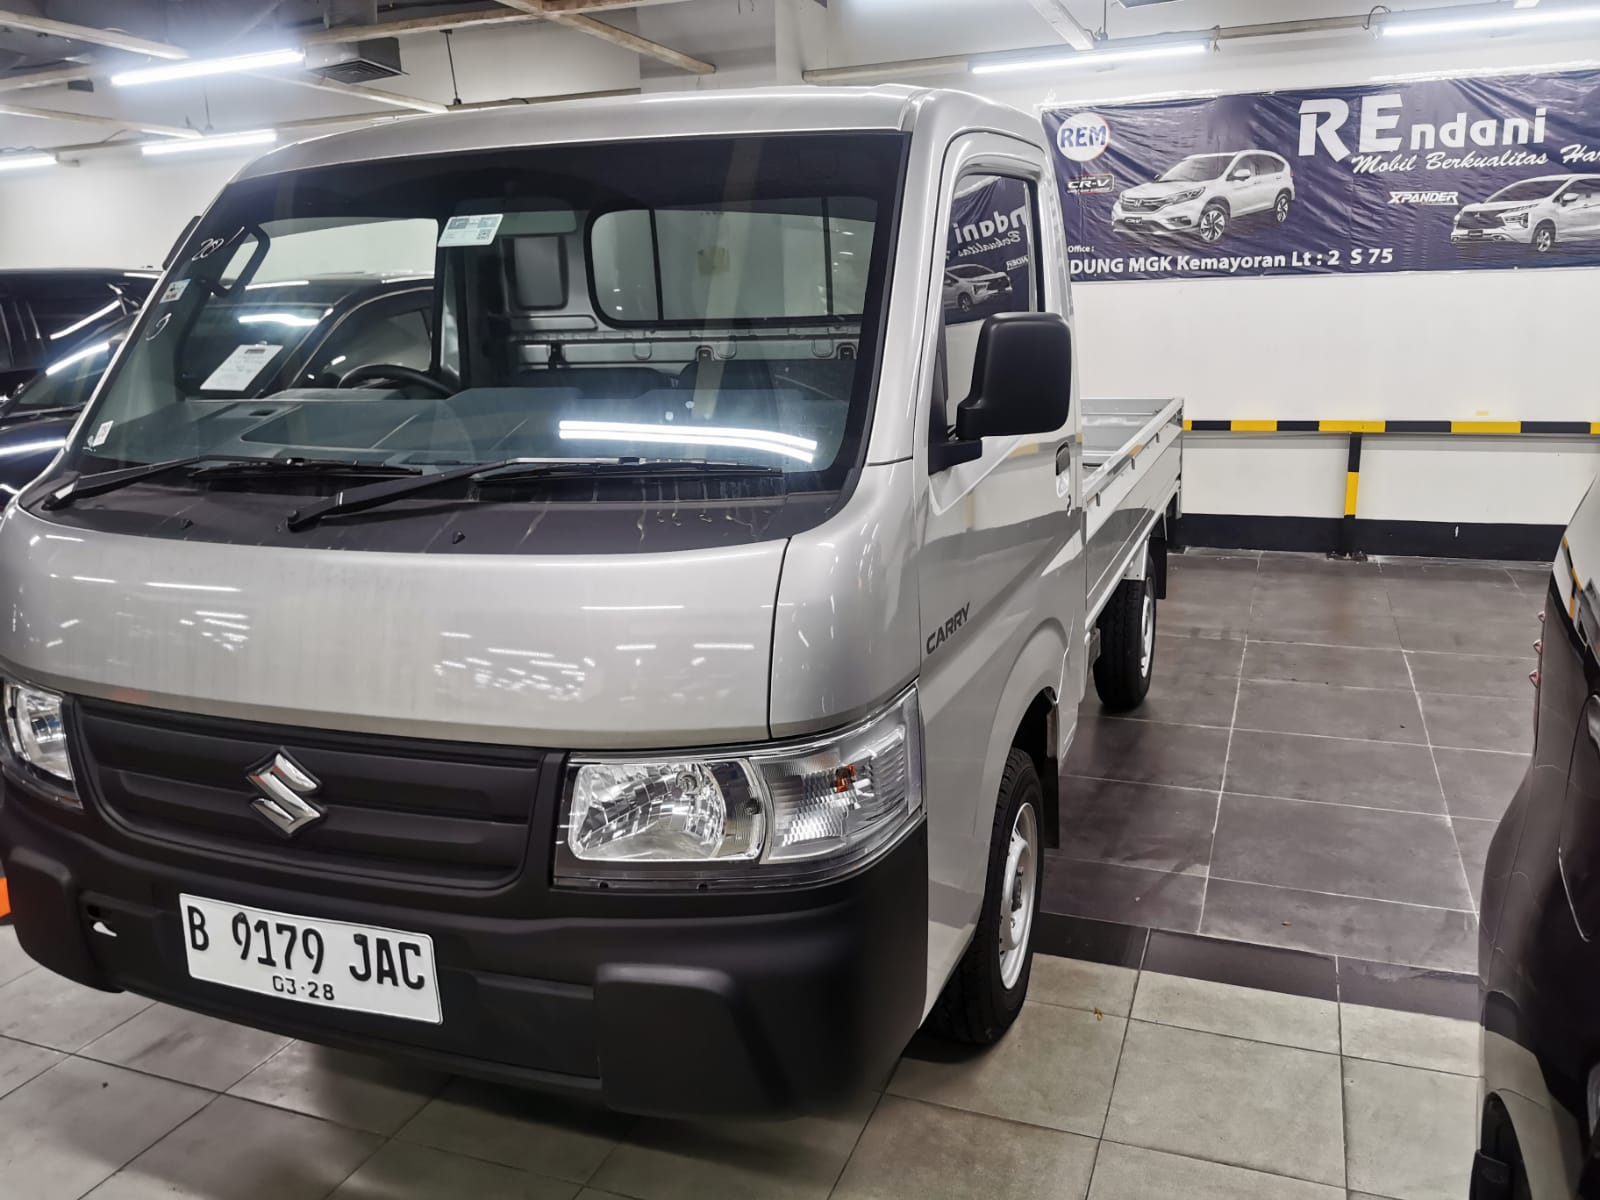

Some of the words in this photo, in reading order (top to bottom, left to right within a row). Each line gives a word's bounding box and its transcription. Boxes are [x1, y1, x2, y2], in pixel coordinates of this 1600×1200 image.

[1060, 125, 1106, 148] REM
[1351, 154, 1417, 174] Mobil
[1425, 149, 1549, 170] Berkualitas
[1067, 179, 1110, 189] CR-V
[1387, 191, 1459, 205] XPANDER
[1128, 256, 1173, 273] MGK
[1176, 254, 1286, 273] Kemayoran
[1327, 250, 1340, 266] 2
[1350, 249, 1362, 265] S
[1368, 248, 1393, 264] 75
[926, 601, 970, 655] CARRY
[187, 905, 209, 951] B
[232, 911, 324, 974] 9179
[349, 933, 425, 990] JAC
